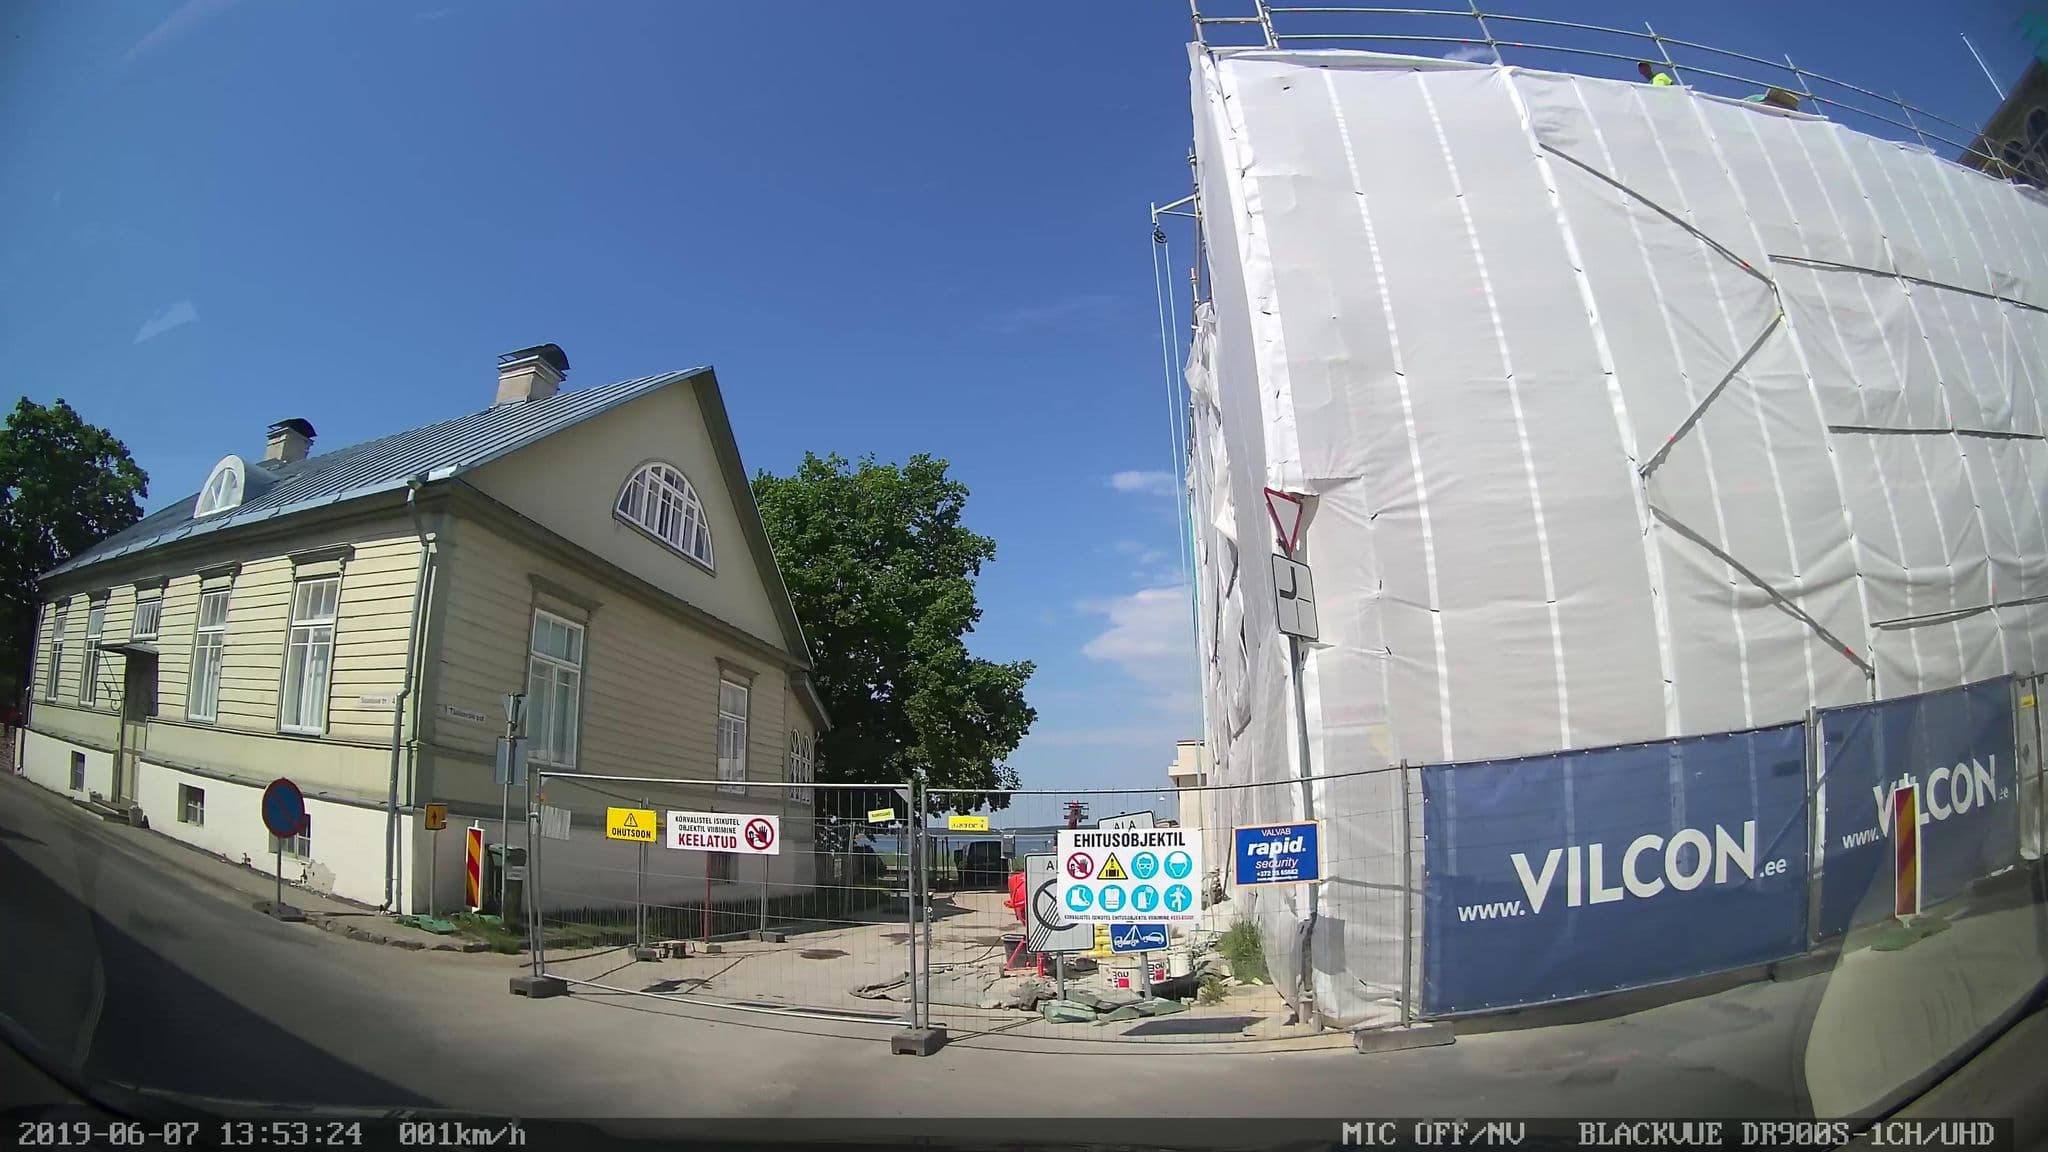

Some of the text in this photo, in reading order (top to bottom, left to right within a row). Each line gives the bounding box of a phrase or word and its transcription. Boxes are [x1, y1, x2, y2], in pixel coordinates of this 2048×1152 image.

[713, 817, 740, 826] ISIKUTEL
[612, 827, 651, 839] OHUTSOON
[678, 825, 705, 833] OBJEKTIL
[678, 833, 737, 849] KEELATUD
[1074, 832, 1185, 848] EHITUSOBJEKTIL
[1255, 857, 1299, 870] security
